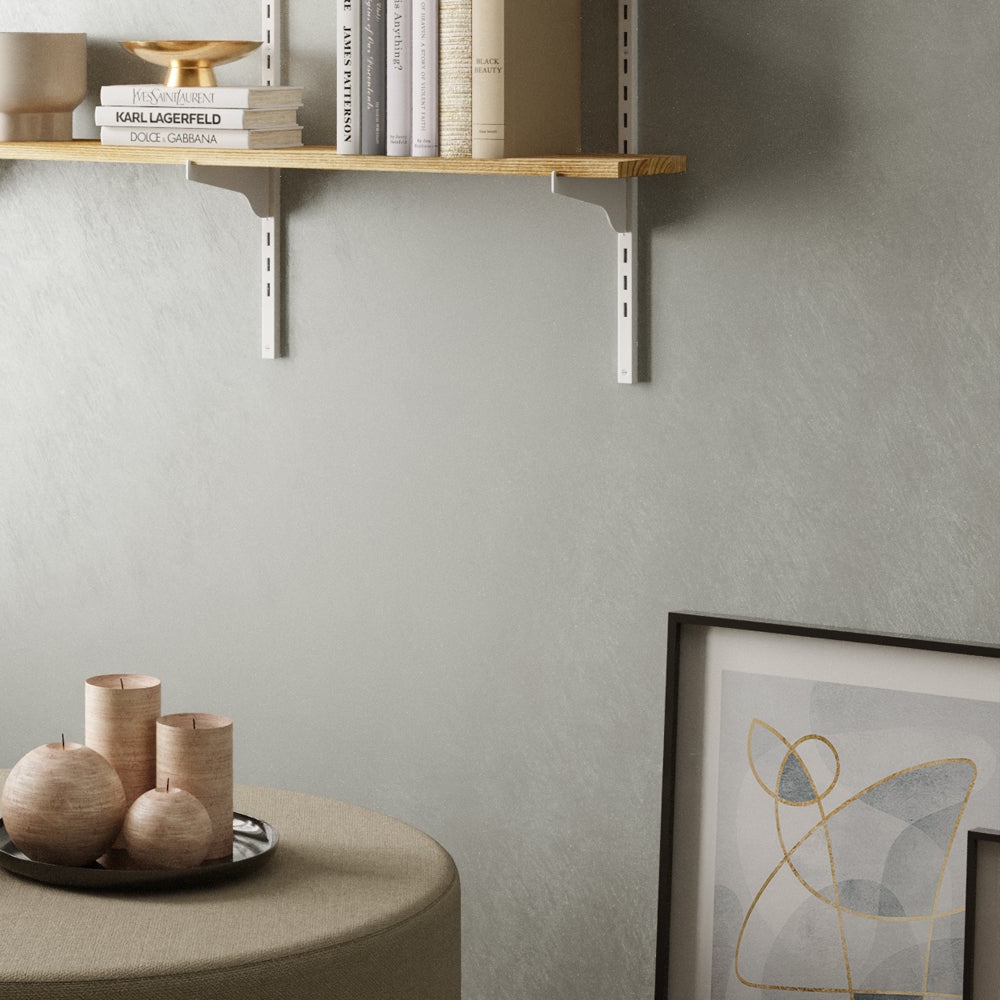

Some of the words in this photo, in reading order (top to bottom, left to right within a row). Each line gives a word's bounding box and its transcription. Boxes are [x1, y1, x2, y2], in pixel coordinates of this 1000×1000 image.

[420, 2, 426, 11] OF
[365, 24, 374, 36] of
[343, 25, 351, 67] JAMES
[393, 13, 403, 71] Anything?
[420, 72, 426, 81] OF
[343, 71, 351, 143] PATTERSON
[116, 112, 147, 123] KARL
[150, 113, 221, 125] LAGERFELD
[130, 132, 161, 143] DOLCE
[167, 133, 218, 144] GABBANA
